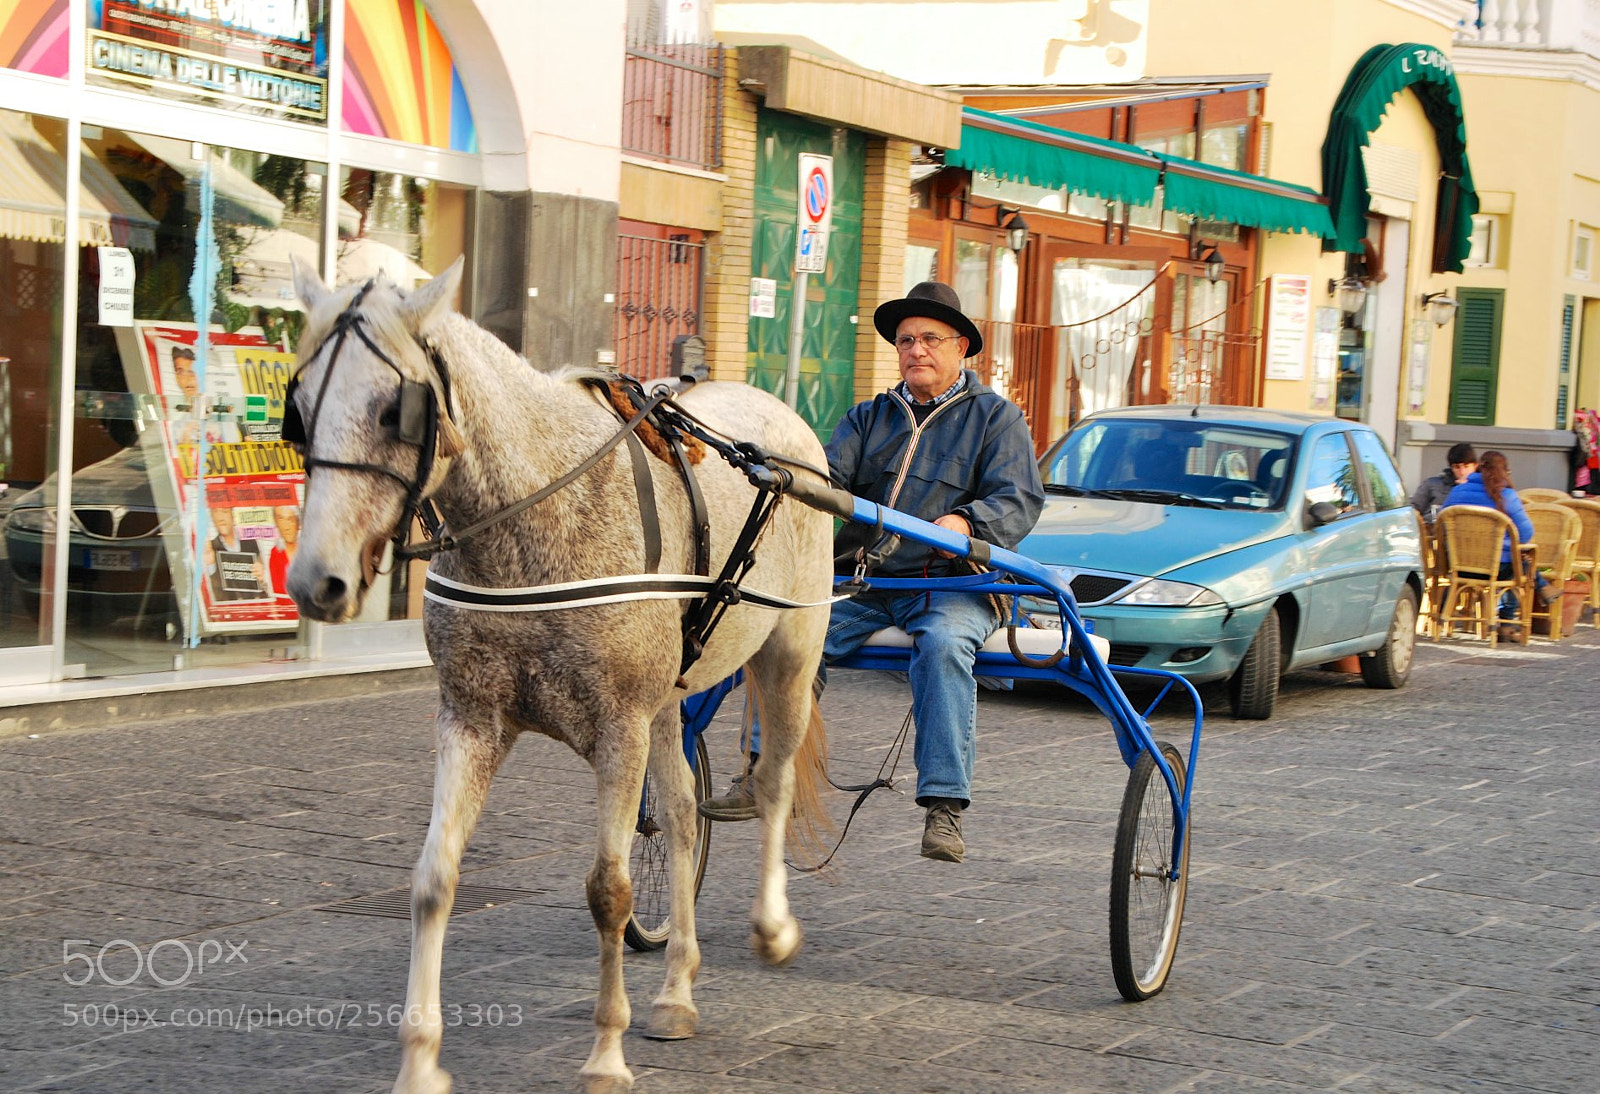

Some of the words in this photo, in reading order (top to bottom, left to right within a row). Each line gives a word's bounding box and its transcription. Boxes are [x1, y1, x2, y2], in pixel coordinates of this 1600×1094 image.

[94, 39, 174, 80] CINEMA
[176, 56, 238, 94] DELLE
[238, 68, 322, 110] VITTORIE
